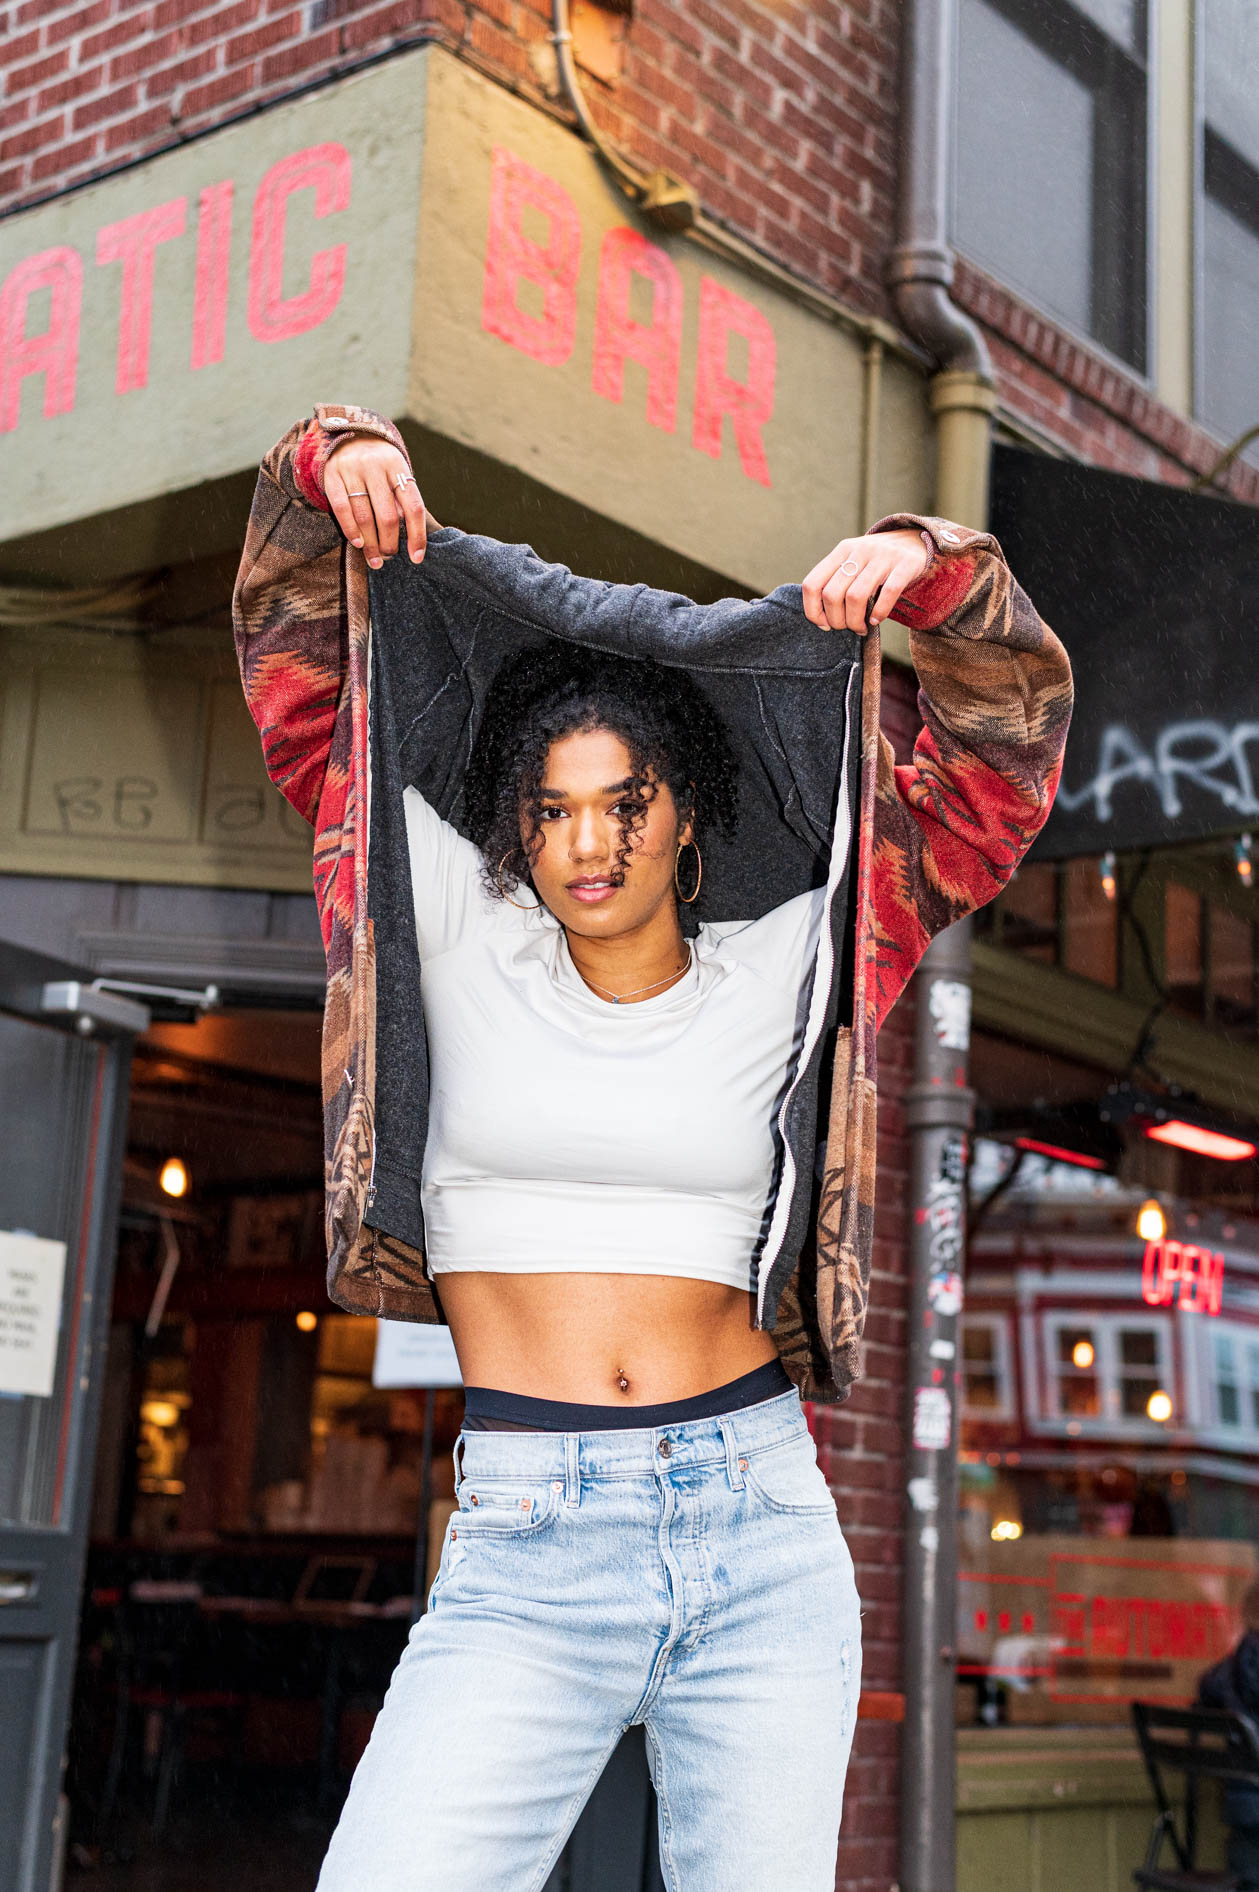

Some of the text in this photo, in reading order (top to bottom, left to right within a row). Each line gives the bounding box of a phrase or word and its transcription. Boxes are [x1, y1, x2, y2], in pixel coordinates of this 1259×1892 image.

[0, 141, 352, 434] ATIC
[481, 143, 773, 490] BAR
[1141, 1239, 1224, 1317] OPEN
